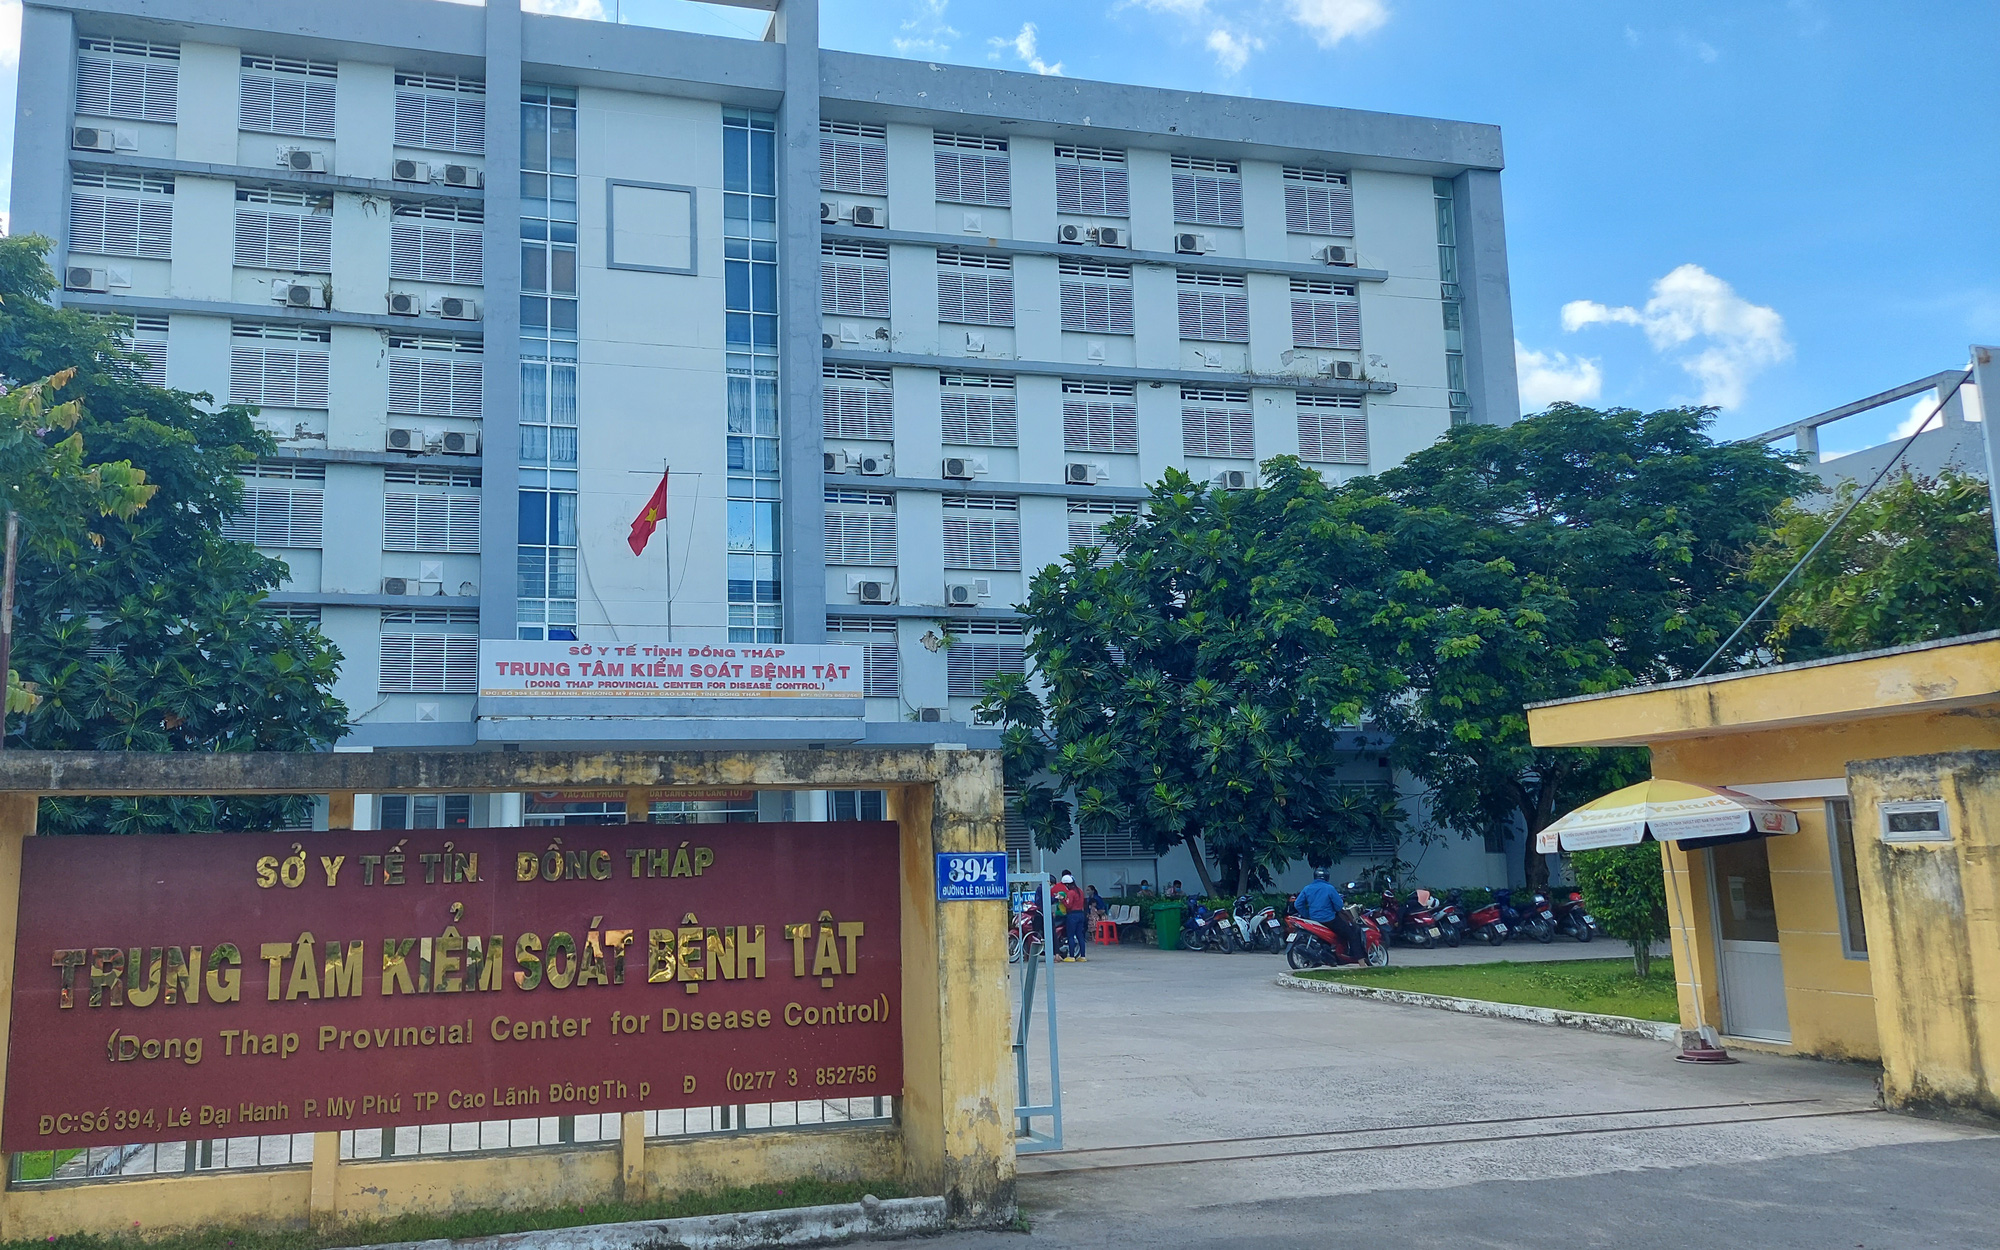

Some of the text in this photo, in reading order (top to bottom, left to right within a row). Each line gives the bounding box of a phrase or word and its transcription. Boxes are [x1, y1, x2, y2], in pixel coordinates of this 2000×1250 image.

[569, 644, 593, 656] SỞ
[597, 647, 609, 656] Y
[615, 644, 637, 656] TẾ
[688, 645, 736, 658] ĐỒNG
[741, 648, 786, 659] THÁP
[495, 657, 851, 682] TRUNG TÂM KIỂM SOÁT BỆNH TẬT
[525, 680, 560, 689] (DONG
[598, 681, 659, 689] PROVINCIAL
[663, 681, 703, 689] CENTER
[775, 682, 825, 691] CONTROL)
[1647, 799, 1732, 813] Yakult
[256, 842, 307, 888] SỞ
[319, 855, 346, 887] Y
[358, 838, 409, 886] TẾ
[514, 837, 613, 882] ĐỒNG
[626, 841, 714, 878] THÁP
[948, 858, 998, 883] 394
[965, 884, 974, 896] LÊ
[987, 884, 1004, 895] HÀNH
[52, 902, 865, 1009] TRUNG TÂM KIỂM SOÁT BỆNH TẬT
[107, 1028, 203, 1065] (Dong
[219, 1029, 300, 1059] Thap
[490, 1014, 592, 1042] Center
[610, 1010, 650, 1035] for
[783, 993, 890, 1027] Control)
[114, 1108, 162, 1132] 394,
[238, 1101, 289, 1123] Hanh
[303, 1099, 321, 1119] P.
[327, 1096, 356, 1120] My
[362, 1092, 401, 1115] Phú
[413, 1091, 439, 1111] TP
[448, 1089, 486, 1110] Cao
[492, 1085, 540, 1107] Lãnh
[725, 1067, 776, 1091] (0277
[787, 1068, 798, 1086] 3
[815, 1064, 877, 1086] 852756
